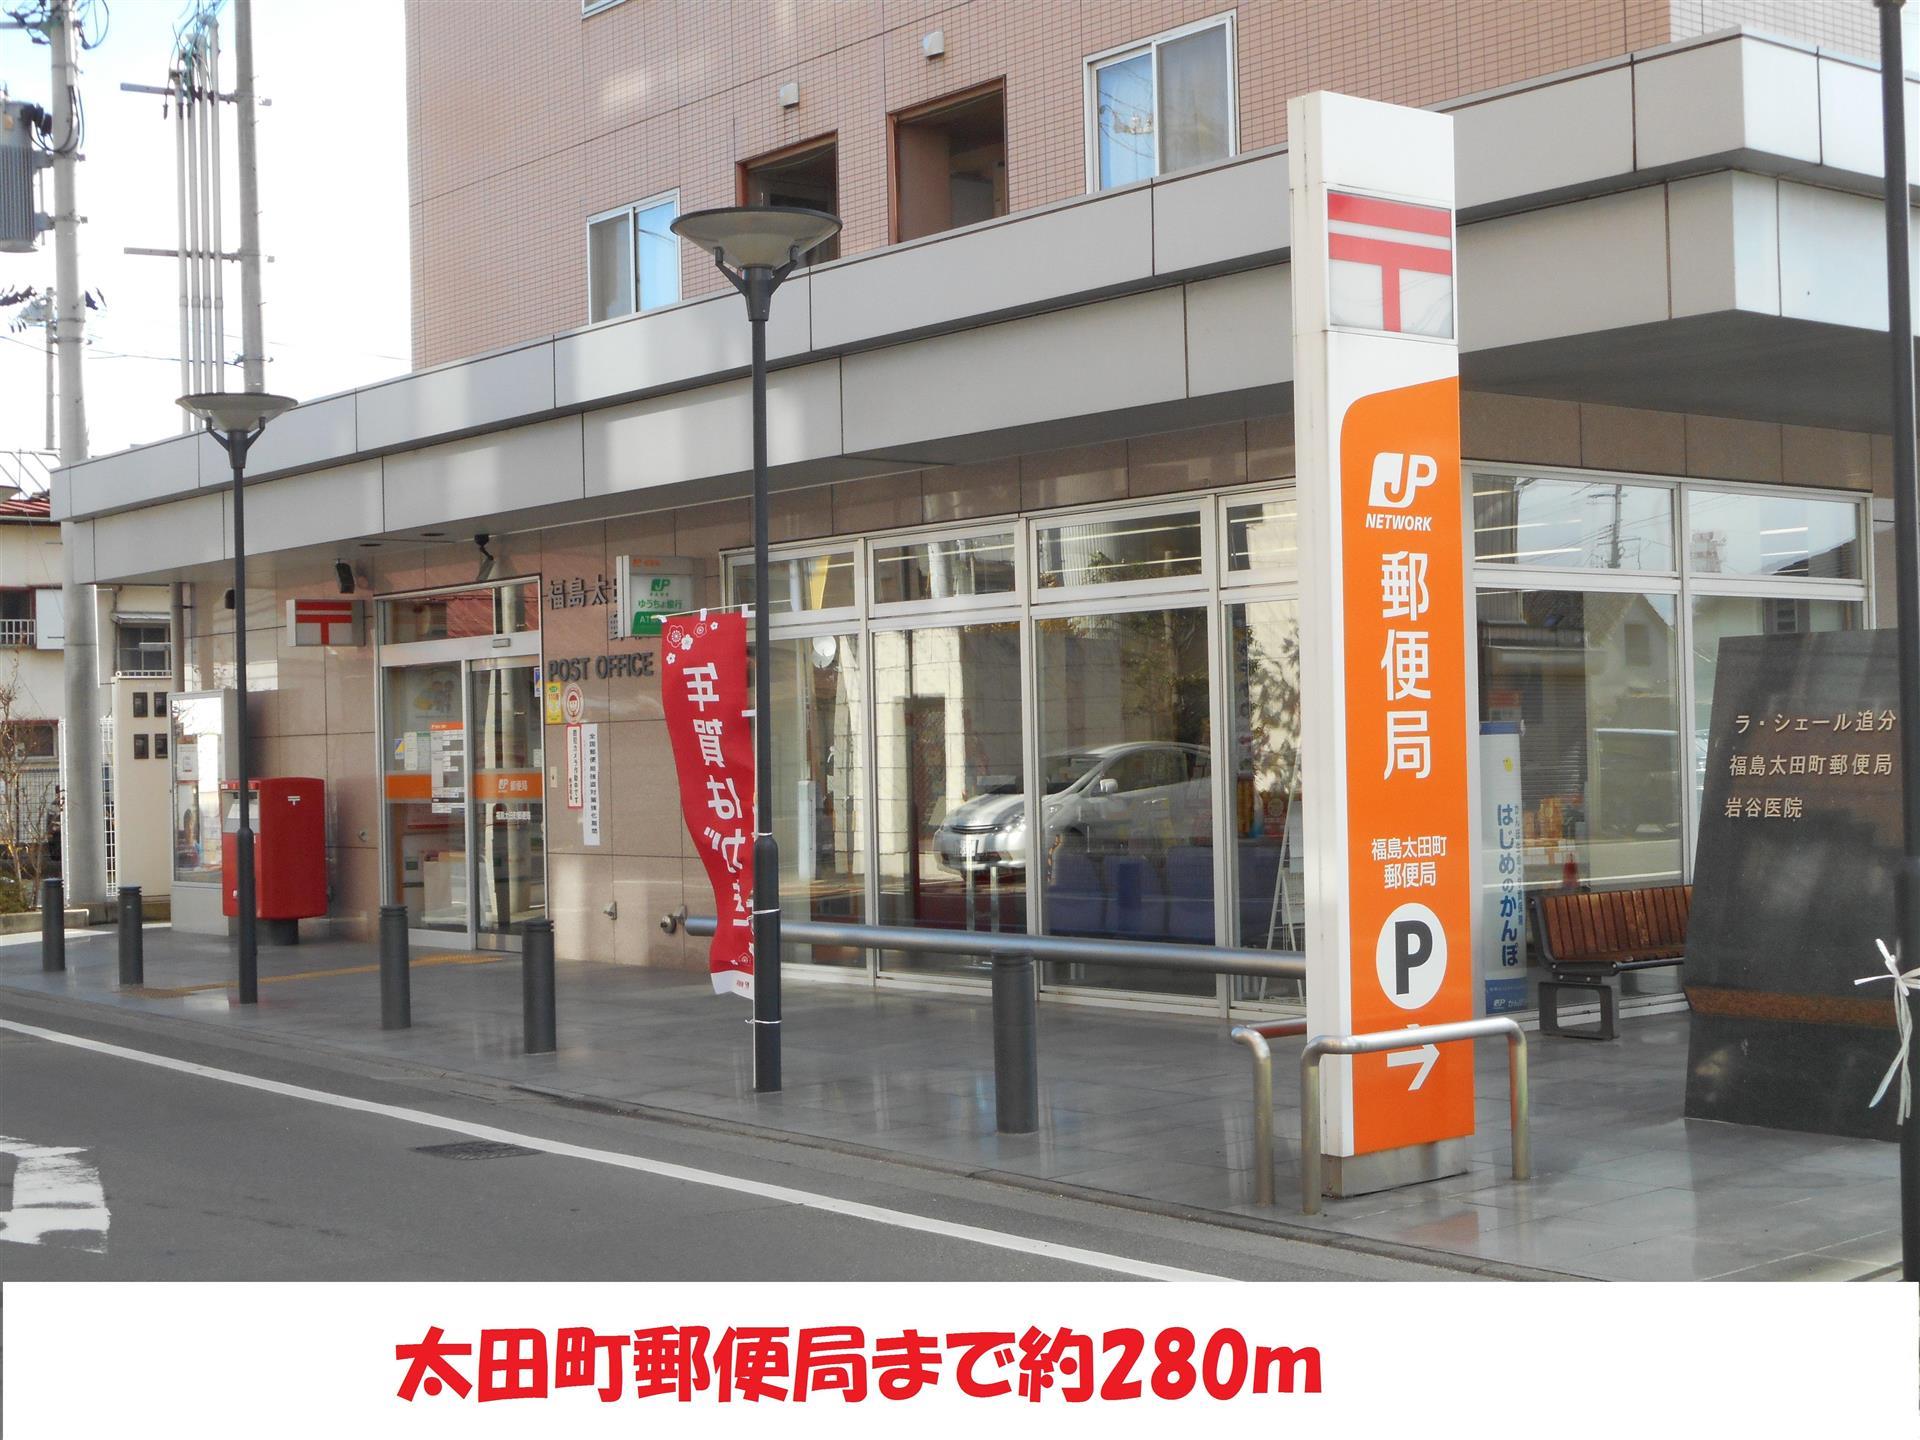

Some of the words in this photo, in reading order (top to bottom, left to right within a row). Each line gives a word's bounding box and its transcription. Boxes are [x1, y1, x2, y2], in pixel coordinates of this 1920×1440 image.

[1367, 452, 1437, 508] JP
[1365, 513, 1432, 532] NETWORK
[550, 574, 617, 610] 福島太
[638, 598, 683, 610] ゆうちょ銀行
[549, 657, 590, 682] POST
[596, 652, 655, 679] OFFICE
[1380, 550, 1432, 780] 郵便局
[1735, 709, 1897, 734] ラ・シェール追分
[1729, 753, 1893, 777] 福島太田町郵便局
[1724, 796, 1804, 819] 岩谷医院
[1371, 836, 1447, 861] 福島太田町
[1383, 862, 1437, 889] 郵便局
[1497, 804, 1519, 967] はじめのかんぽ
[1395, 920, 1433, 996] P
